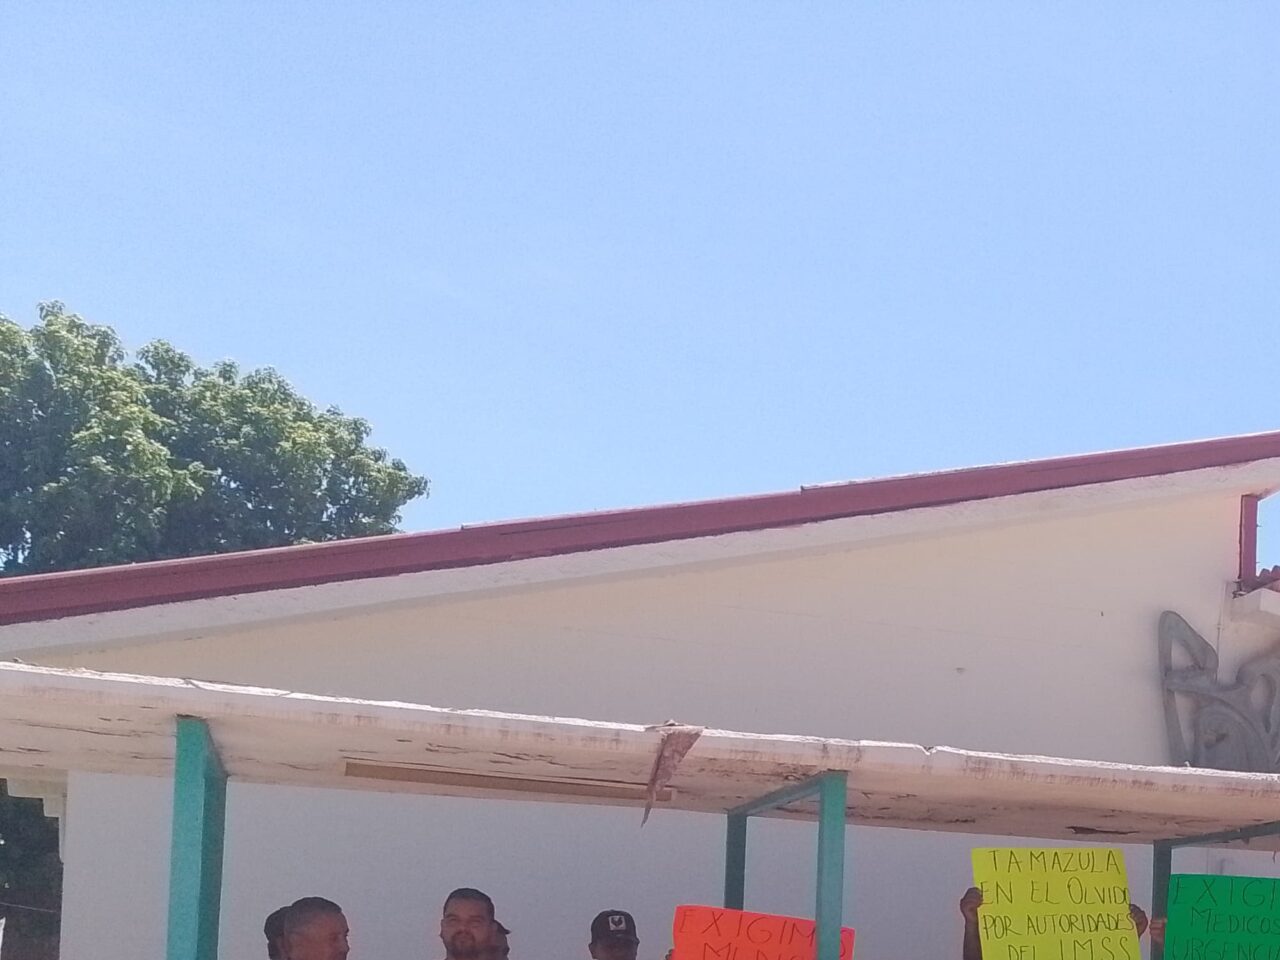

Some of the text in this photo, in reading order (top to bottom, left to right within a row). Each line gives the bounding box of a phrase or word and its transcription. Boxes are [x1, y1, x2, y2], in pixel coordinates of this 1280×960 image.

[988, 850, 1120, 875] TAMAZULA
[980, 881, 1014, 905] EN
[1031, 881, 1061, 905] EL
[679, 909, 847, 958] EXIGIMS
[983, 912, 1135, 941] POR AUTORIDADES
